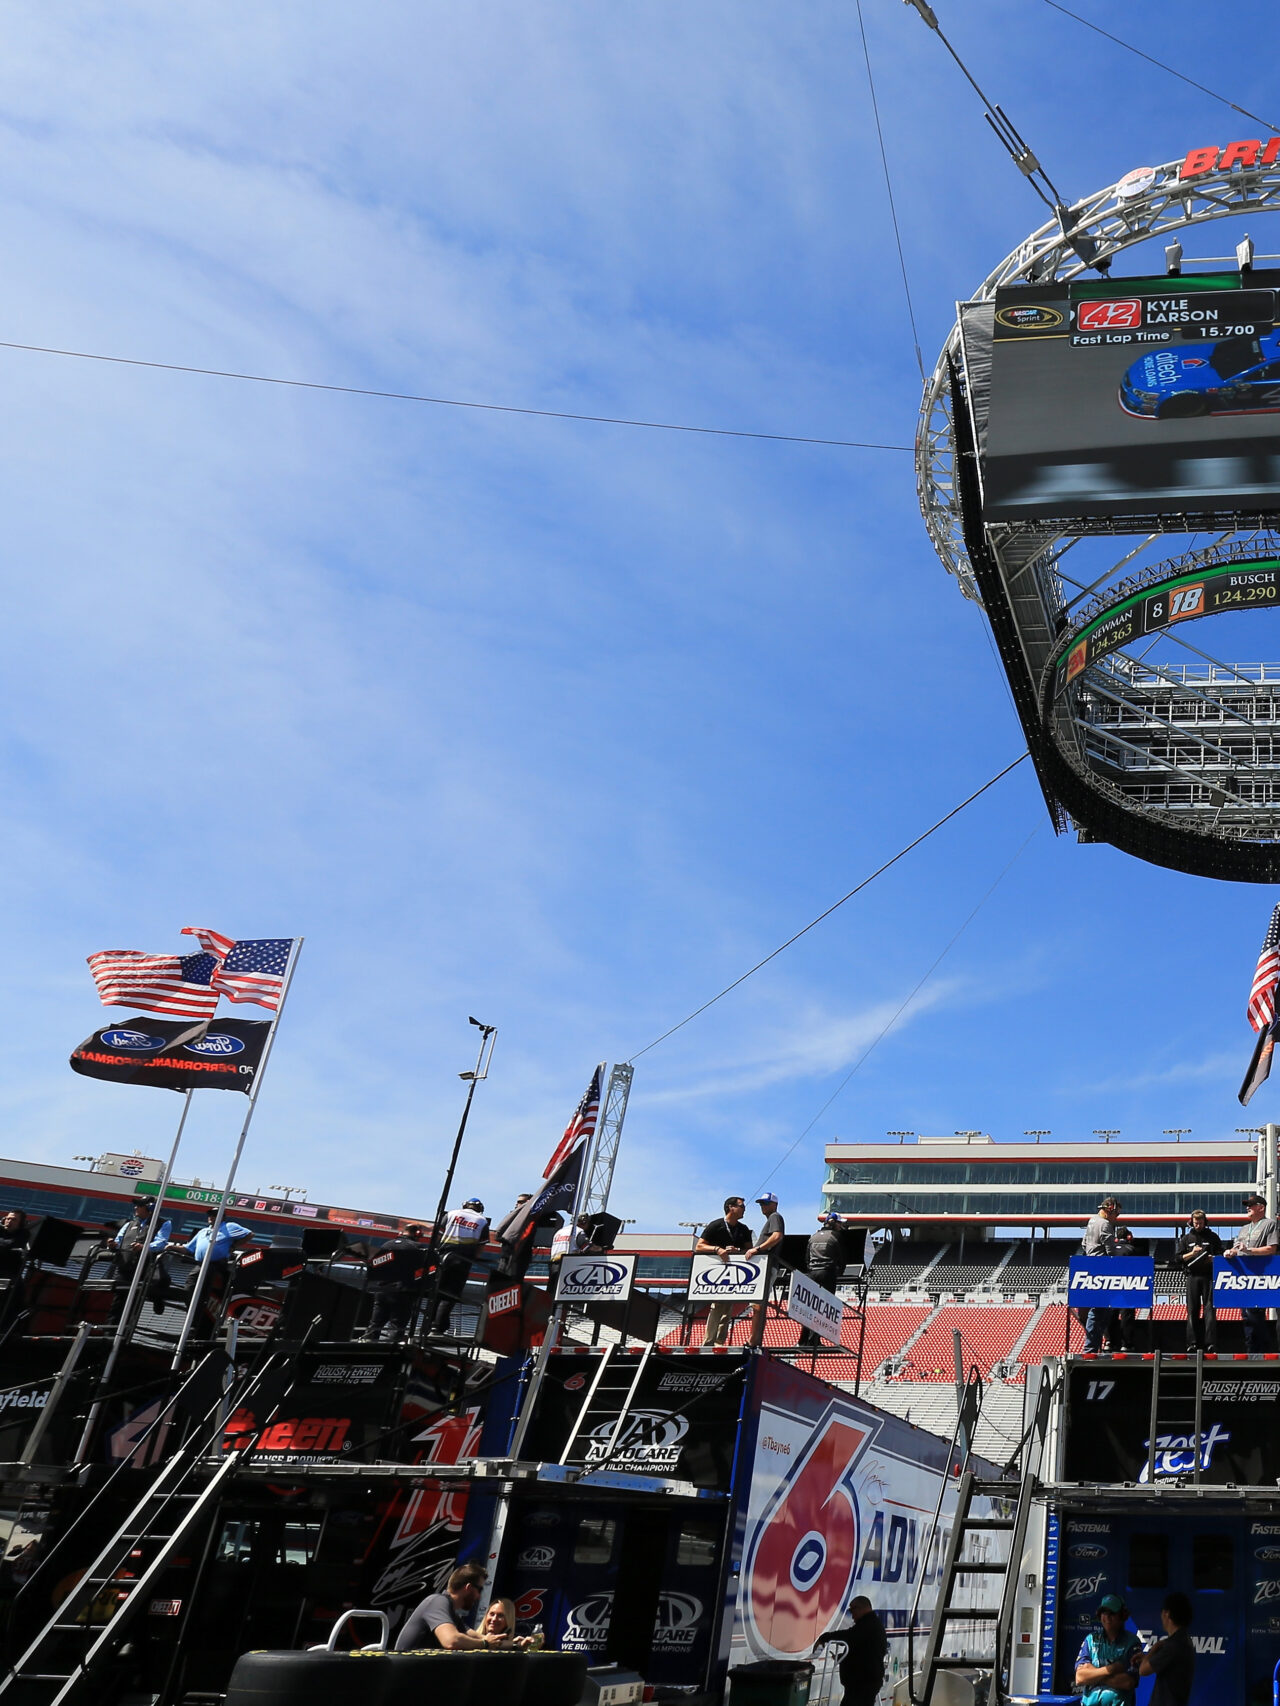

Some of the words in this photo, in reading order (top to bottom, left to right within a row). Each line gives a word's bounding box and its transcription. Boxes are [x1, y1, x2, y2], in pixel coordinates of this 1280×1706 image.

[1083, 303, 1134, 328] 42
[1147, 300, 1188, 312] KYLE
[1017, 315, 1040, 323] Sprint
[1147, 310, 1218, 324] LARSON
[1073, 335, 1101, 345] Fast
[1106, 334, 1131, 345] Lap
[1136, 331, 1170, 342] Time
[1200, 325, 1255, 337] 15.700
[1155, 352, 1182, 384] ditech
[1230, 573, 1275, 586] BUSCH
[1170, 587, 1203, 616] 18
[1214, 586, 1277, 605] 124.290
[1153, 603, 1163, 618] 8
[1091, 609, 1133, 643] NEWMAN
[1091, 624, 1132, 657] 124.363
[1059, 669, 1066, 683] 7
[186, 1190, 234, 1206] 00:18:6
[236, 1198, 249, 1207] 2
[255, 1201, 266, 1210] 19
[560, 1284, 624, 1294] ADVOCARE
[692, 1284, 757, 1294] ADVOCARE
[1070, 1271, 1150, 1290] FASTENAL
[793, 1284, 841, 1325] ADVOCARE
[240, 1306, 279, 1326] PET
[563, 1372, 588, 1391] 6
[660, 1373, 693, 1386] ROUSH
[694, 1373, 726, 1386] FENWA
[1202, 1381, 1239, 1395] ROUSH
[1086, 1381, 1115, 1400] 17
[585, 1440, 683, 1463] AOCARE
[762, 1436, 791, 1455] @Tbayne6
[624, 1464, 677, 1472] CHAMPIONS
[747, 1404, 877, 1658] 6
[1066, 1521, 1111, 1533] FASTENAL
[1075, 1546, 1100, 1557] Ford
[514, 1589, 548, 1620] 6
[1136, 1629, 1226, 1654] FANAL
